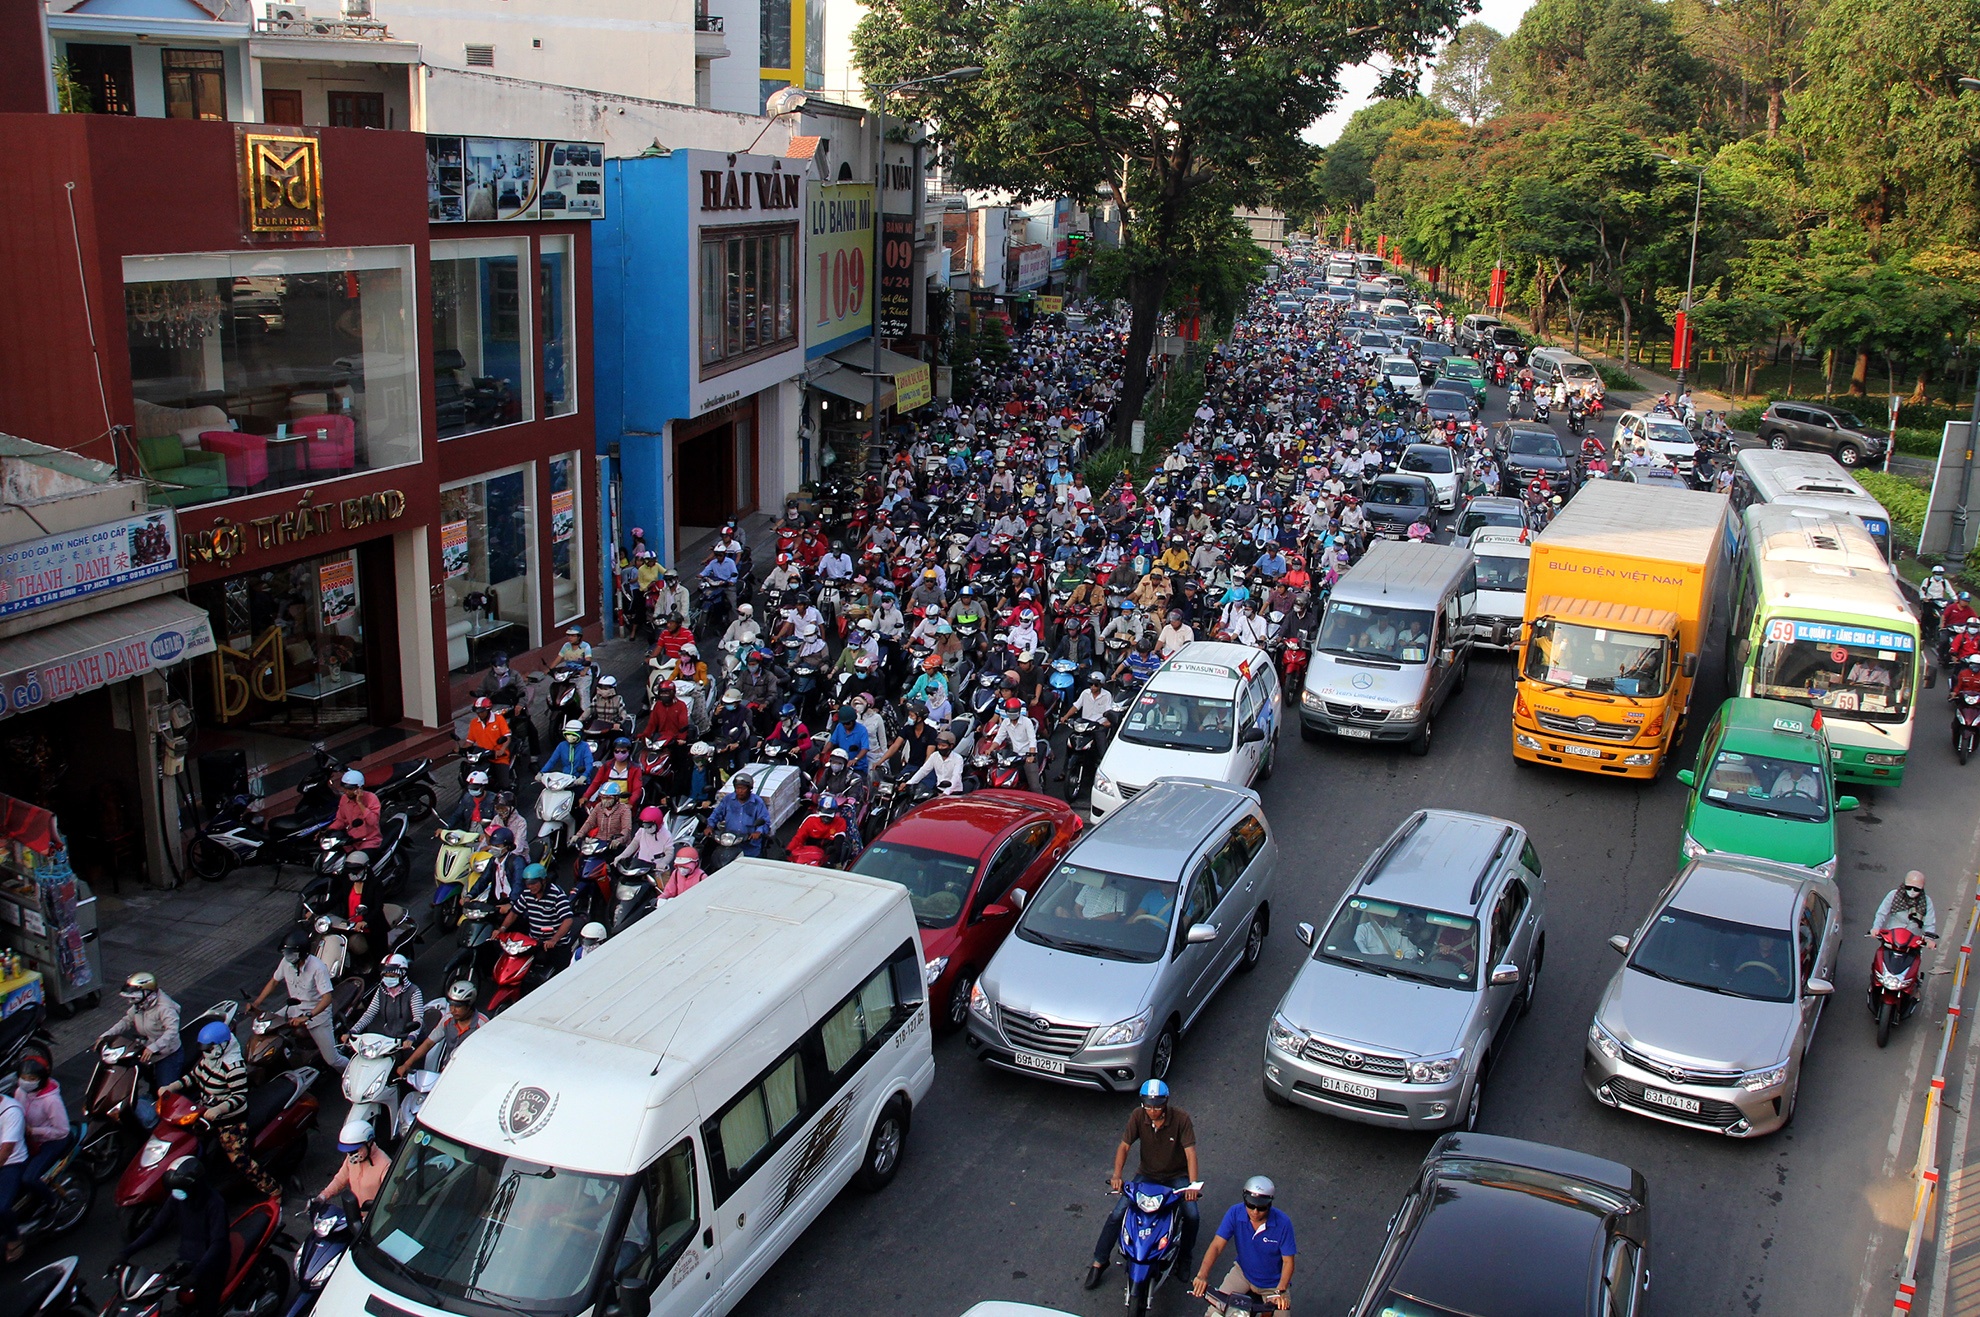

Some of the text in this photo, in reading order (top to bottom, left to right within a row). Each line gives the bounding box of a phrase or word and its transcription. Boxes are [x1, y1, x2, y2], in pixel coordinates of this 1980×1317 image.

[700, 153, 800, 211] HẢI VÂN
[813, 191, 871, 235] LÒ BÁNH MÌ
[817, 247, 864, 326] 109
[92, 531, 108, 542] CAO
[111, 526, 127, 539] CẤP
[184, 489, 406, 568] NỘI THẤT BMD
[15, 568, 63, 599] THANH
[75, 555, 111, 583] DANH
[1549, 561, 1683, 586] BƯU ĐIỆN VIỆT NAM
[1772, 621, 1794, 642] 59
[1809, 626, 1826, 641] QUẬN
[1853, 632, 1866, 643] CHA
[13, 671, 43, 707] GỖ
[44, 654, 104, 700] THANH
[104, 641, 150, 679] DANH
[1185, 664, 1213, 673] VINASUN
[1353, 691, 1376, 700] Limited
[1839, 695, 1854, 710] 59
[1533, 704, 1560, 713] HINO
[1777, 720, 1801, 730] TAXI
